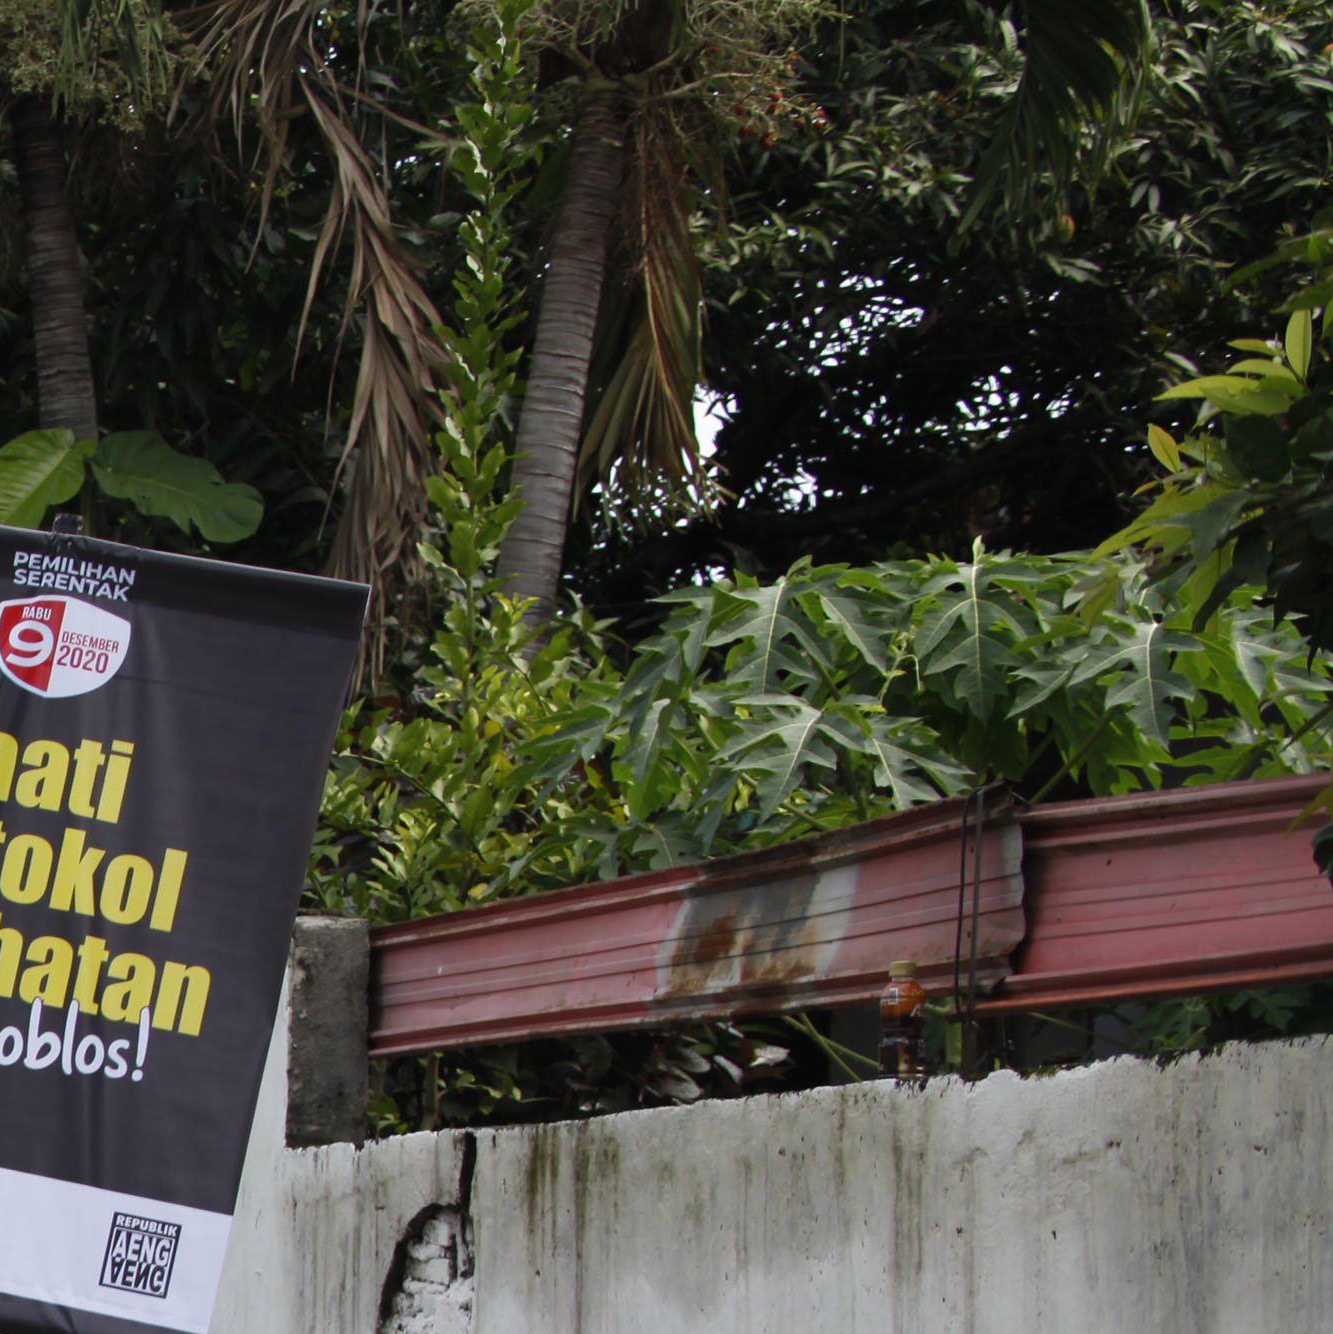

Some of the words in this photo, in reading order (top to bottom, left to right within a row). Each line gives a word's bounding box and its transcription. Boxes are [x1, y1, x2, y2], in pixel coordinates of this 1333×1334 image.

[13, 551, 136, 586] PEMILIHAN
[13, 568, 131, 602] SERENTAK
[21, 606, 52, 621] RABU
[5, 619, 55, 668] 9
[61, 631, 120, 653] DESEMBER
[56, 644, 110, 674] 2020
[115, 1214, 178, 1238] REPUBLIK
[112, 1231, 171, 1267] AENG
